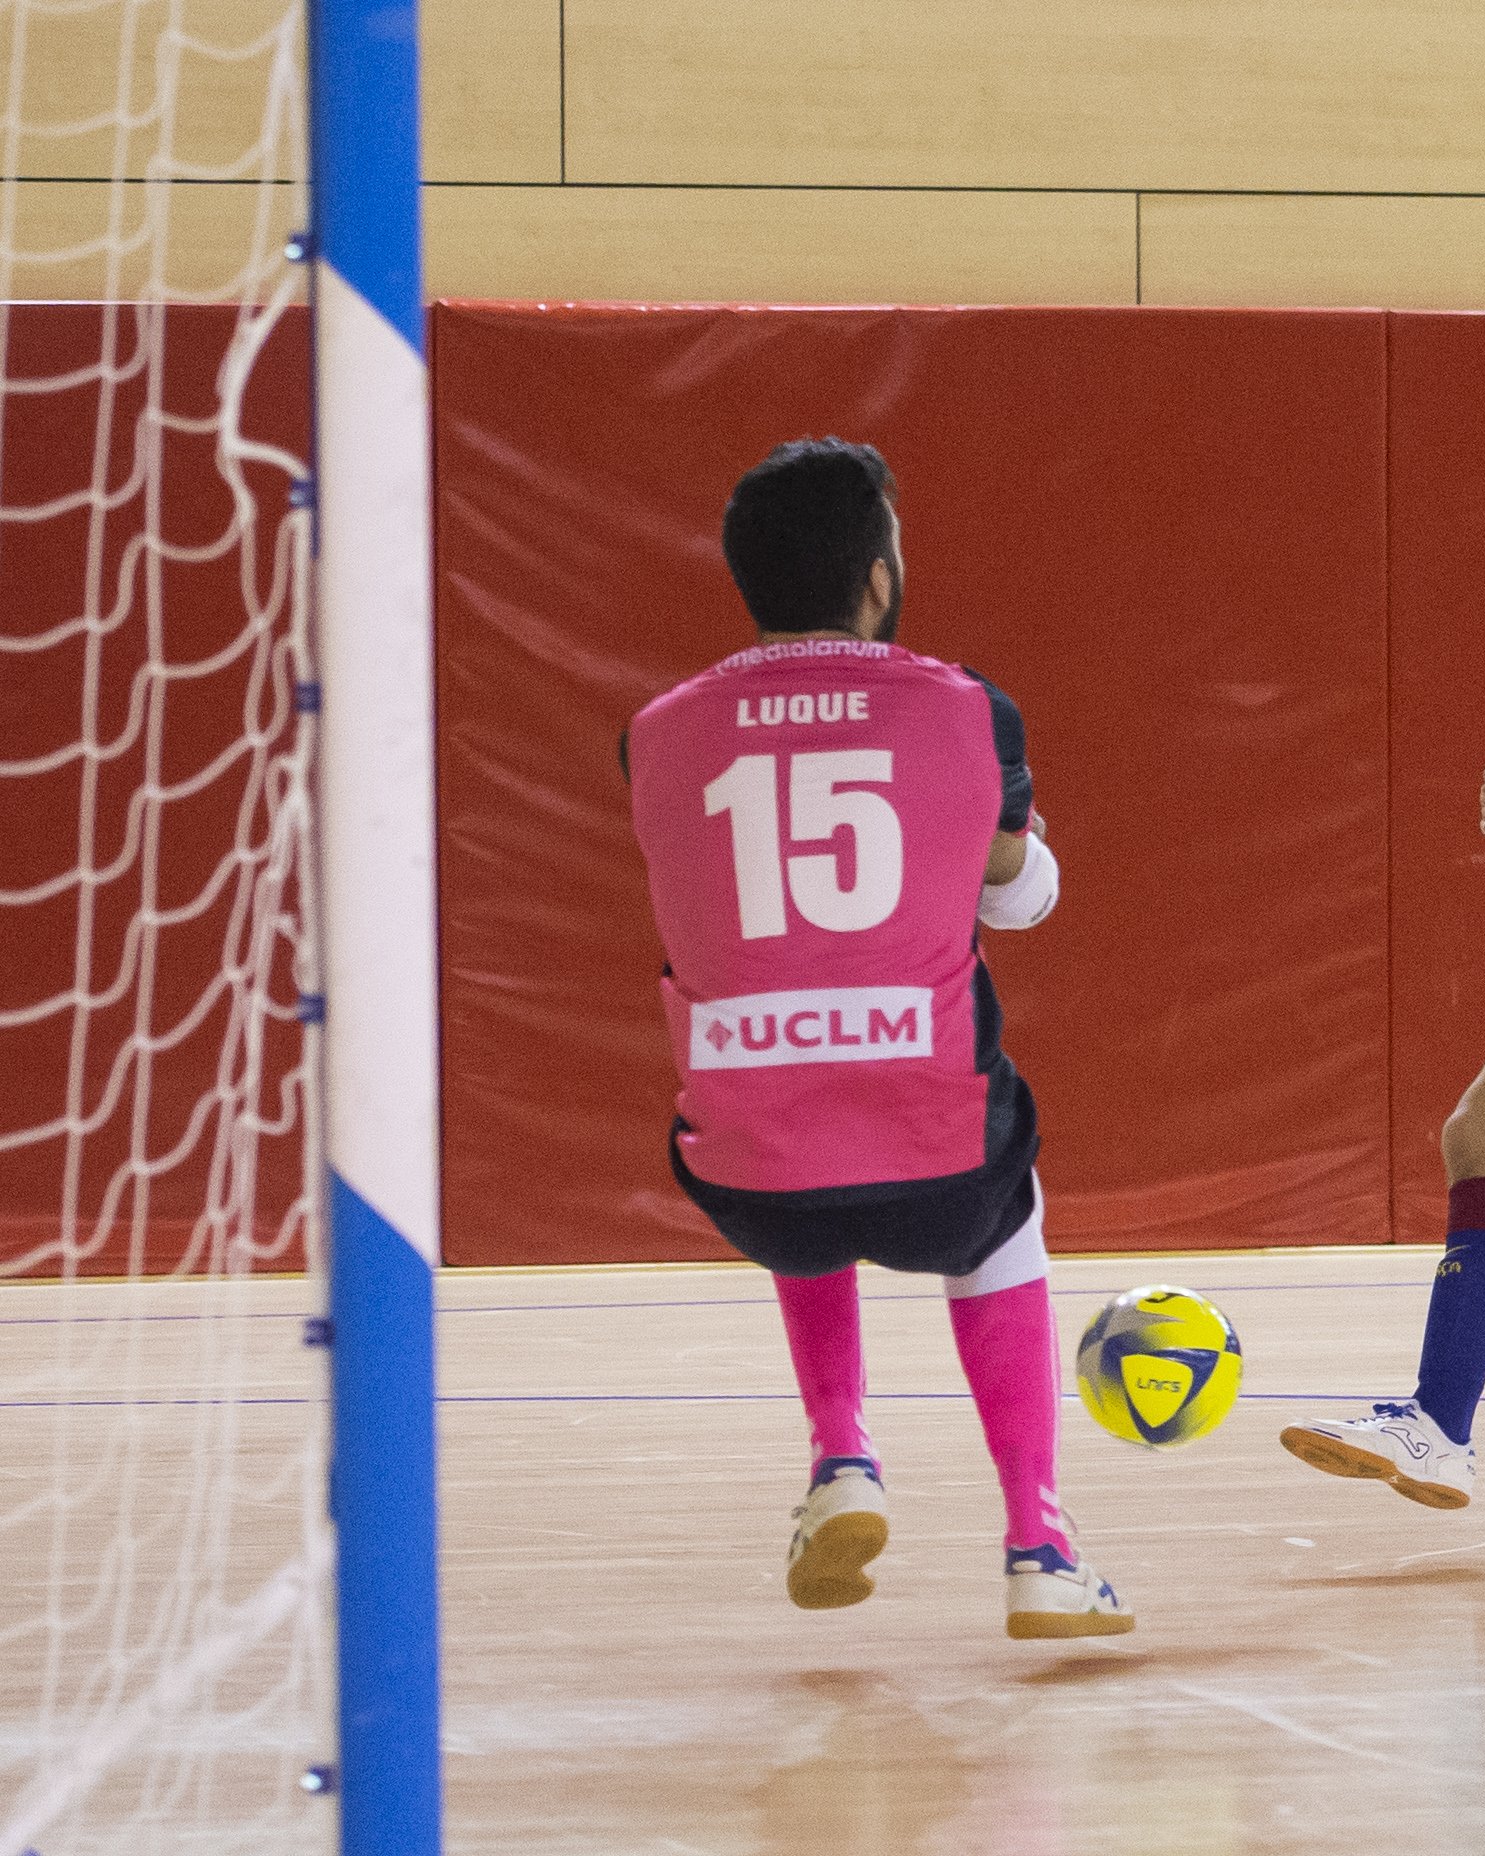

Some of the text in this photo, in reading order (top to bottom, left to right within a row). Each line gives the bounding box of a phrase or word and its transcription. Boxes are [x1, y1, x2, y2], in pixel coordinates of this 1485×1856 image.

[736, 691, 869, 728] LUQUE
[703, 748, 904, 940] 15
[738, 1007, 918, 1051] UCLM
